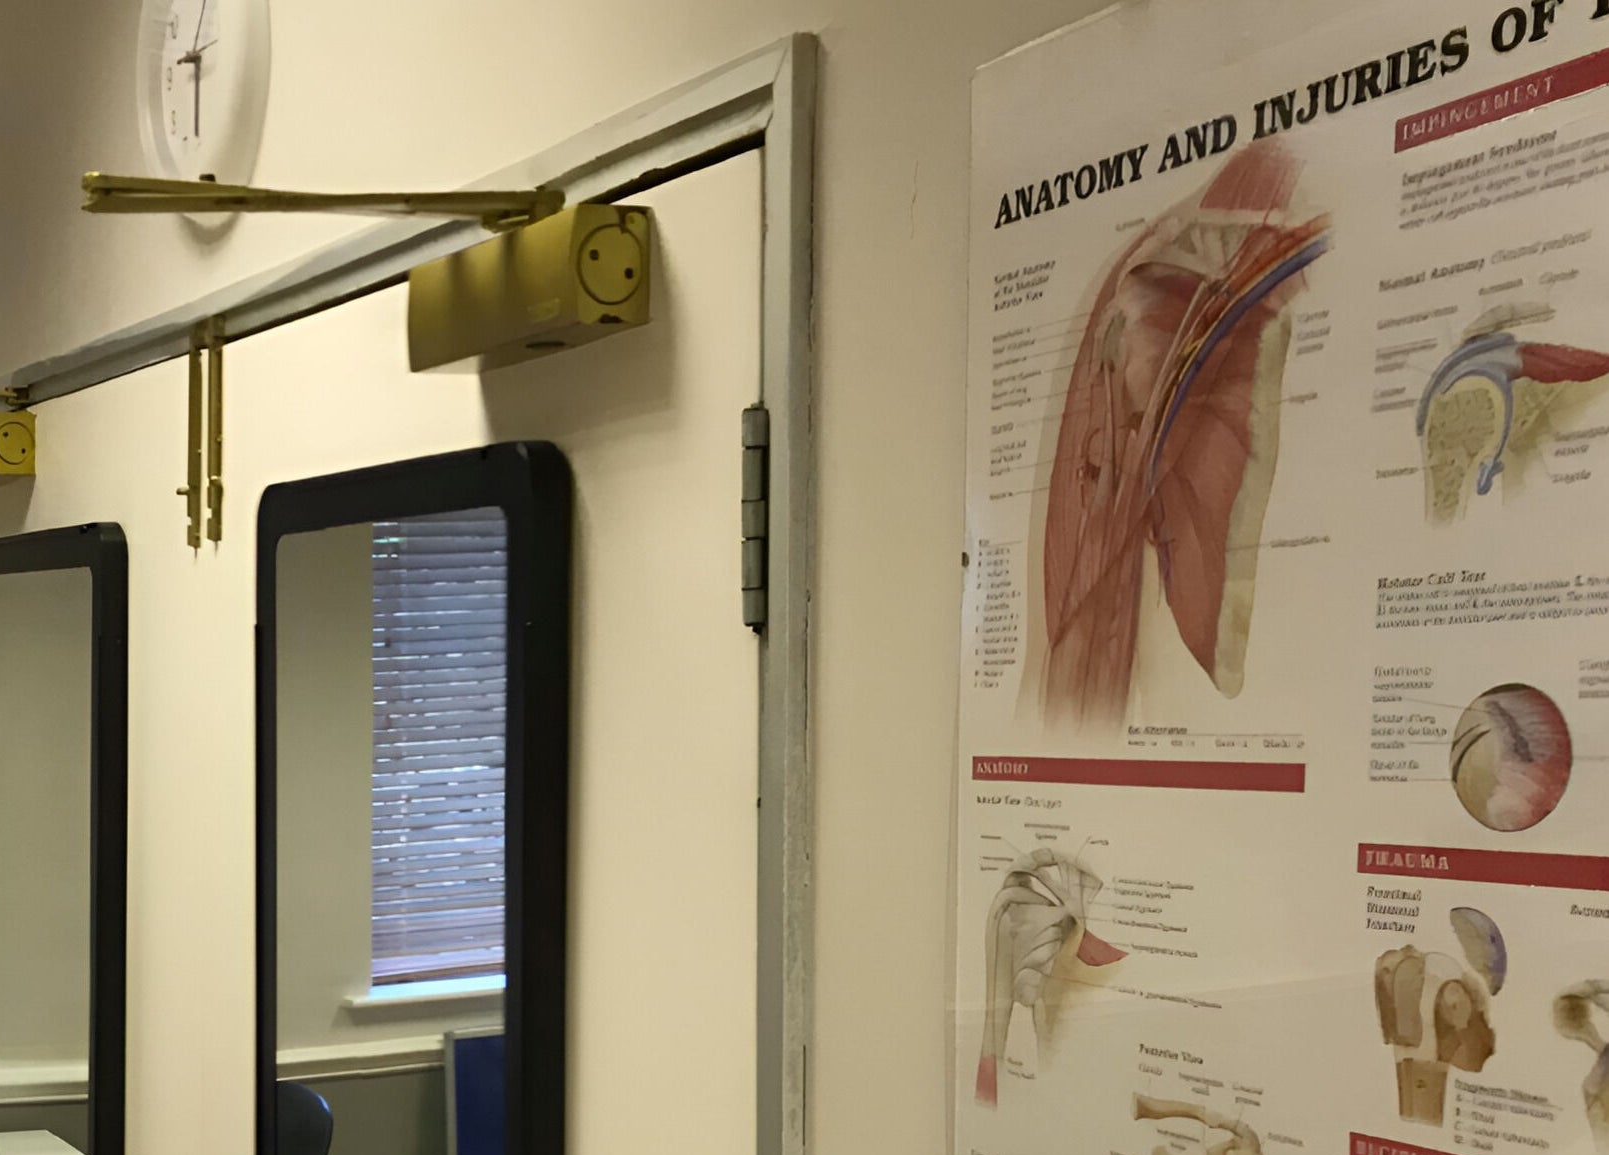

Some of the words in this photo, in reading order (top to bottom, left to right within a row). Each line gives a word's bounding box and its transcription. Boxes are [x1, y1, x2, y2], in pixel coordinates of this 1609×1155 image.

[994, 144, 1149, 229] ANATOMY
[1157, 114, 1238, 174] AND
[1252, 25, 1470, 141] INJURIES
[1491, 0, 1564, 52] OF
